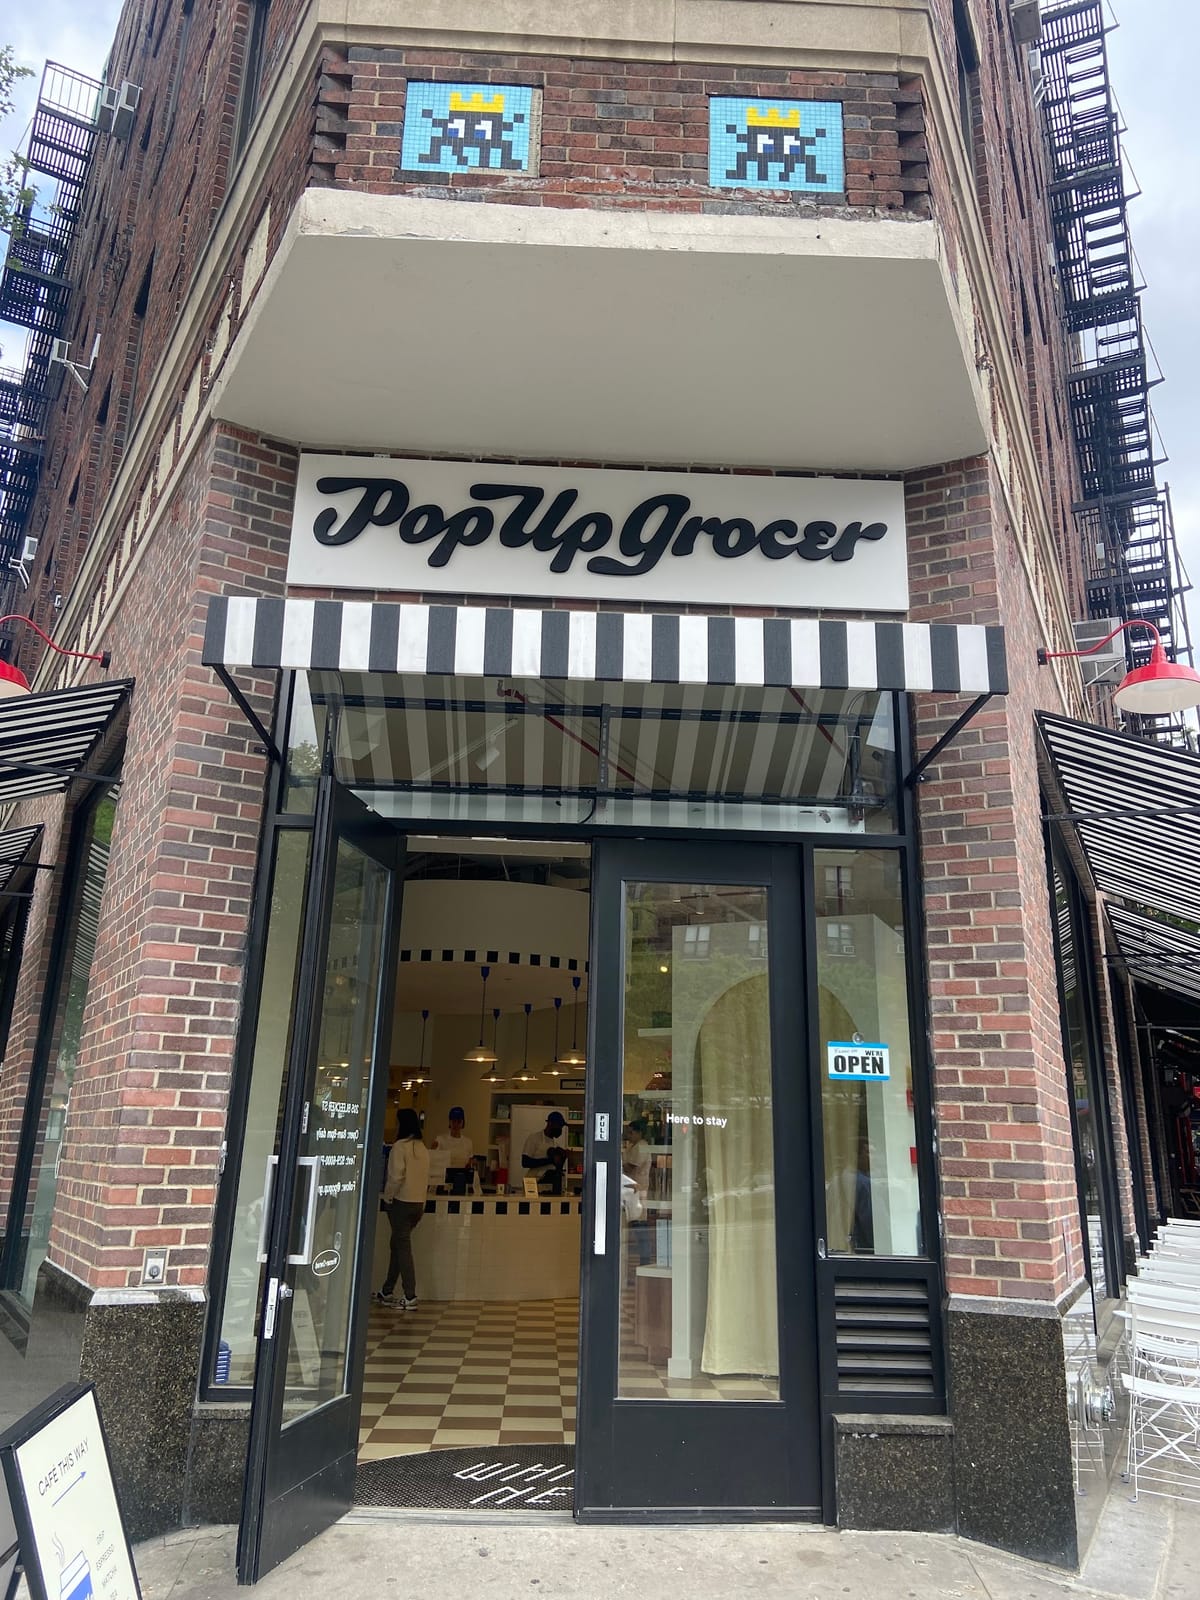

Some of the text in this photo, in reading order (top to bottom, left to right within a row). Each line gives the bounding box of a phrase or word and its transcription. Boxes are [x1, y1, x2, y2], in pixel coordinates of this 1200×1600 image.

[313, 476, 888, 576] Pop Up Grocer
[834, 1055, 884, 1074] OPEN
[666, 1113, 728, 1129] Here to stay
[58, 1452, 75, 1477] THIS
[74, 1437, 89, 1462] WAY
